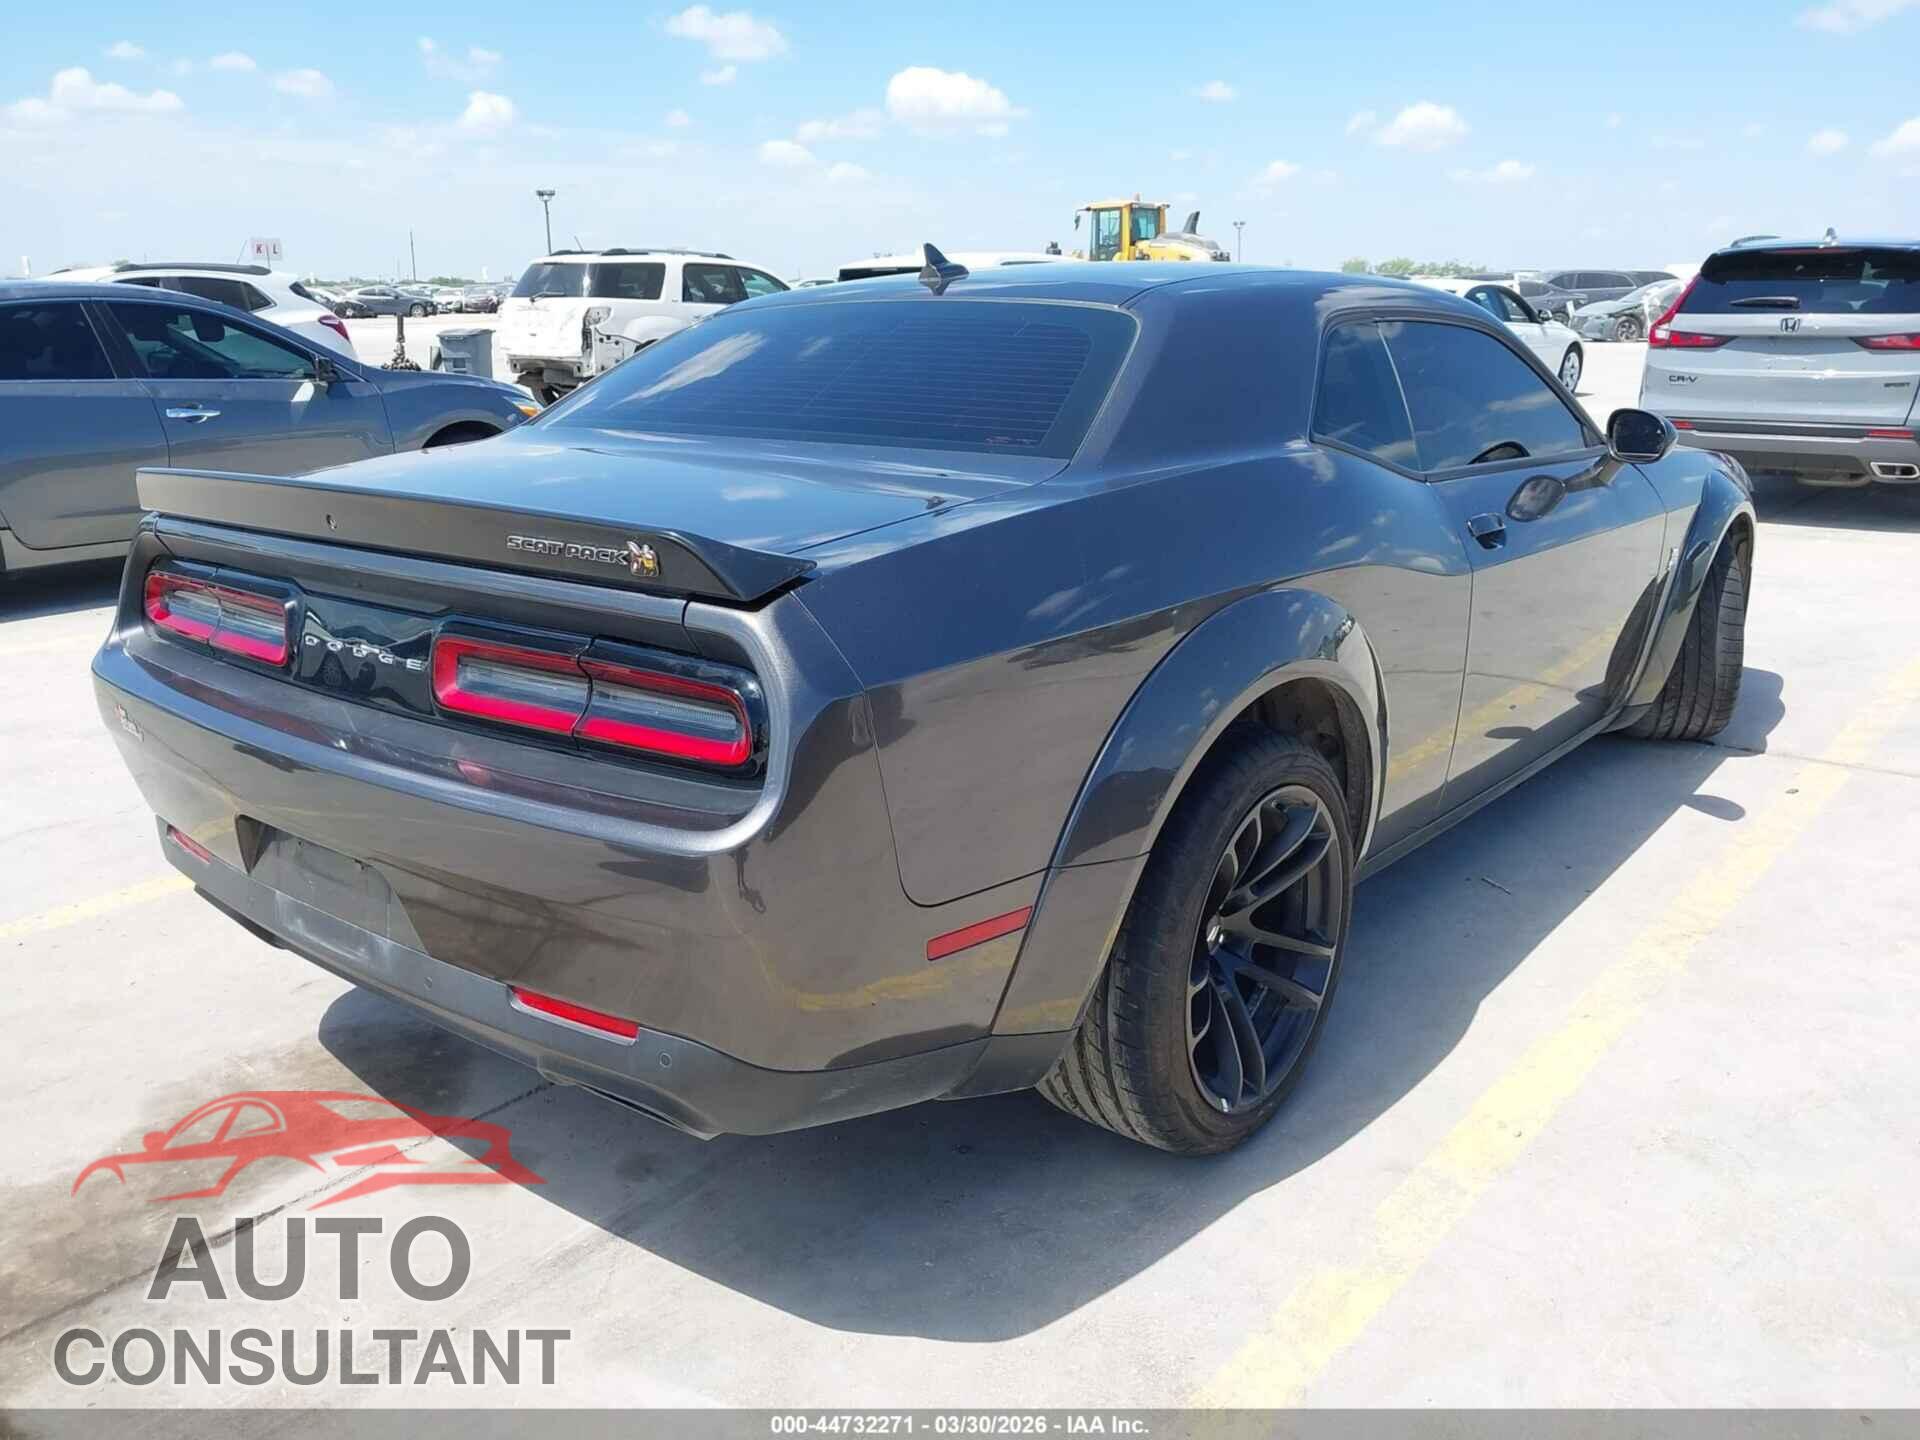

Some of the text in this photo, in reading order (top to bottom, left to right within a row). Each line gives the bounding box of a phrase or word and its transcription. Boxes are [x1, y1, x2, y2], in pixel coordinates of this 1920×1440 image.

[1668, 375, 1698, 383] CR-V
[506, 535, 629, 566] SCAT PACK
[304, 635, 423, 671] DODGE
